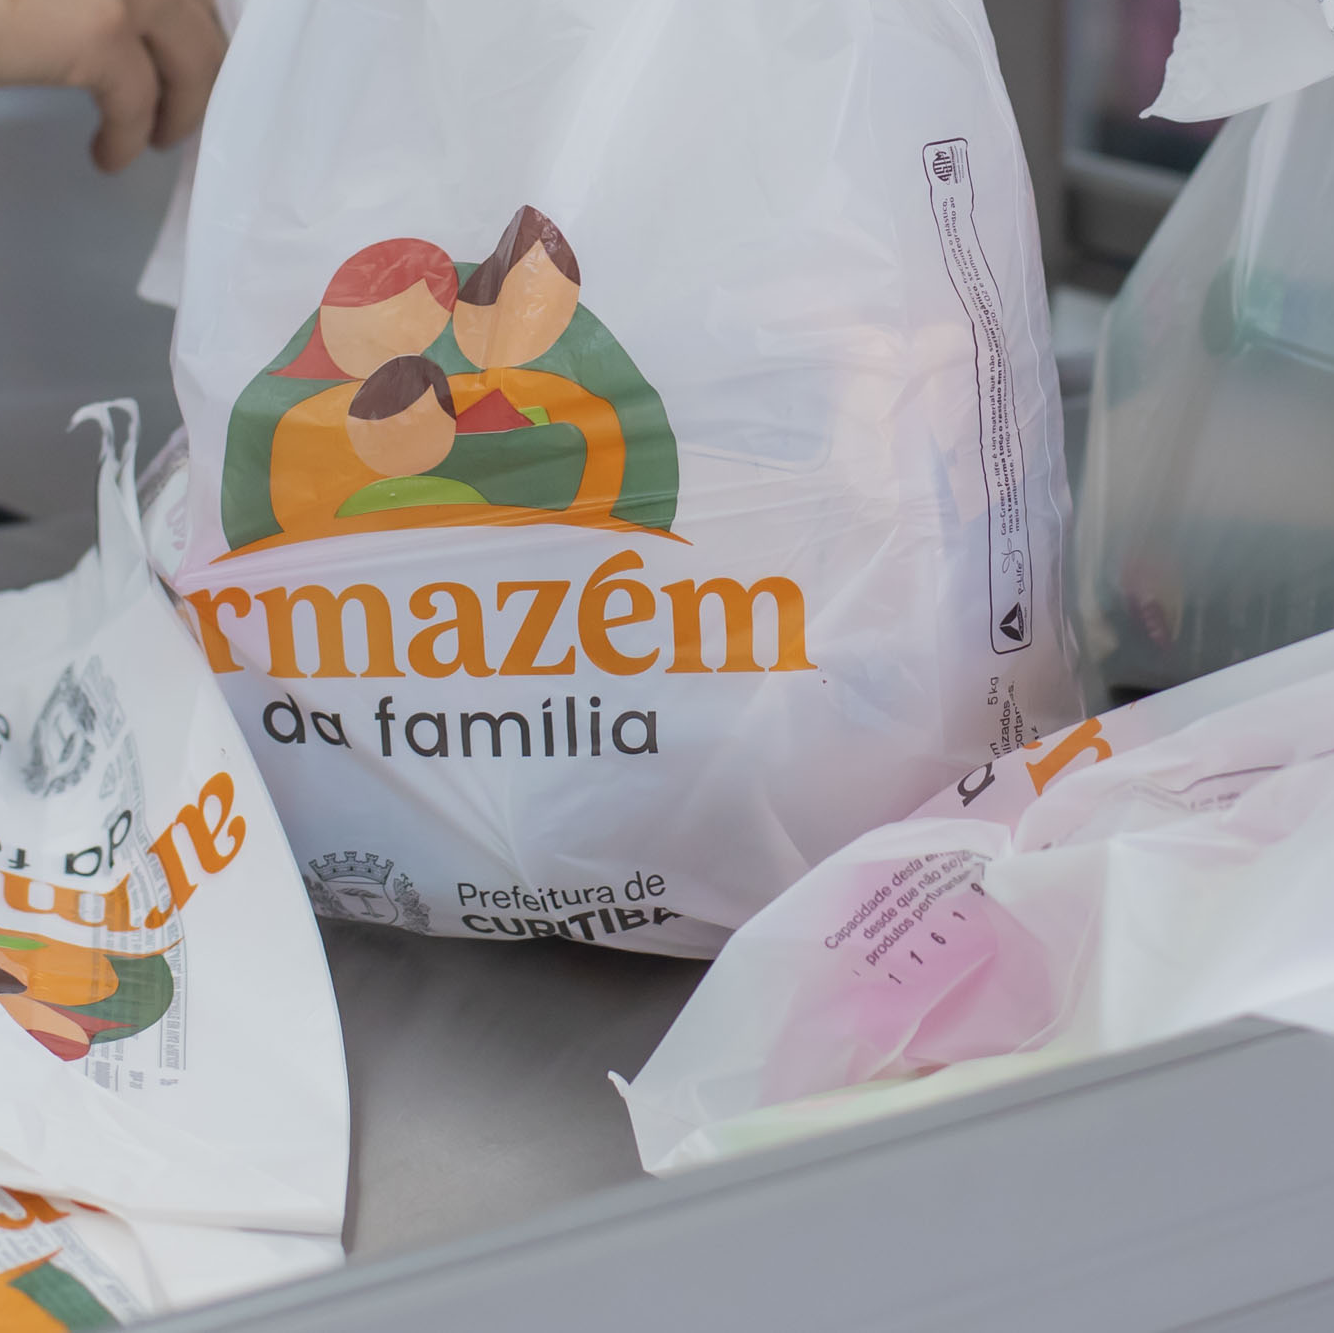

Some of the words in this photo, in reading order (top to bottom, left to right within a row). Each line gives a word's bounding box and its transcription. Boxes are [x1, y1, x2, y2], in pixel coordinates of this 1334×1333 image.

[949, 197, 956, 208] ao
[989, 327, 1002, 363] material
[989, 394, 997, 434] material
[1000, 457, 1013, 512] transforma
[179, 550, 819, 678] rmazém
[262, 695, 352, 751] da
[375, 697, 658, 757] família
[64, 810, 132, 878] da
[457, 880, 616, 913] Prefeitura
[625, 871, 667, 901] de
[824, 885, 892, 949] Capacidade
[892, 857, 923, 887] desta
[863, 906, 898, 940] desde
[896, 887, 920, 909] que
[918, 870, 941, 890] não
[866, 917, 915, 966] produtos
